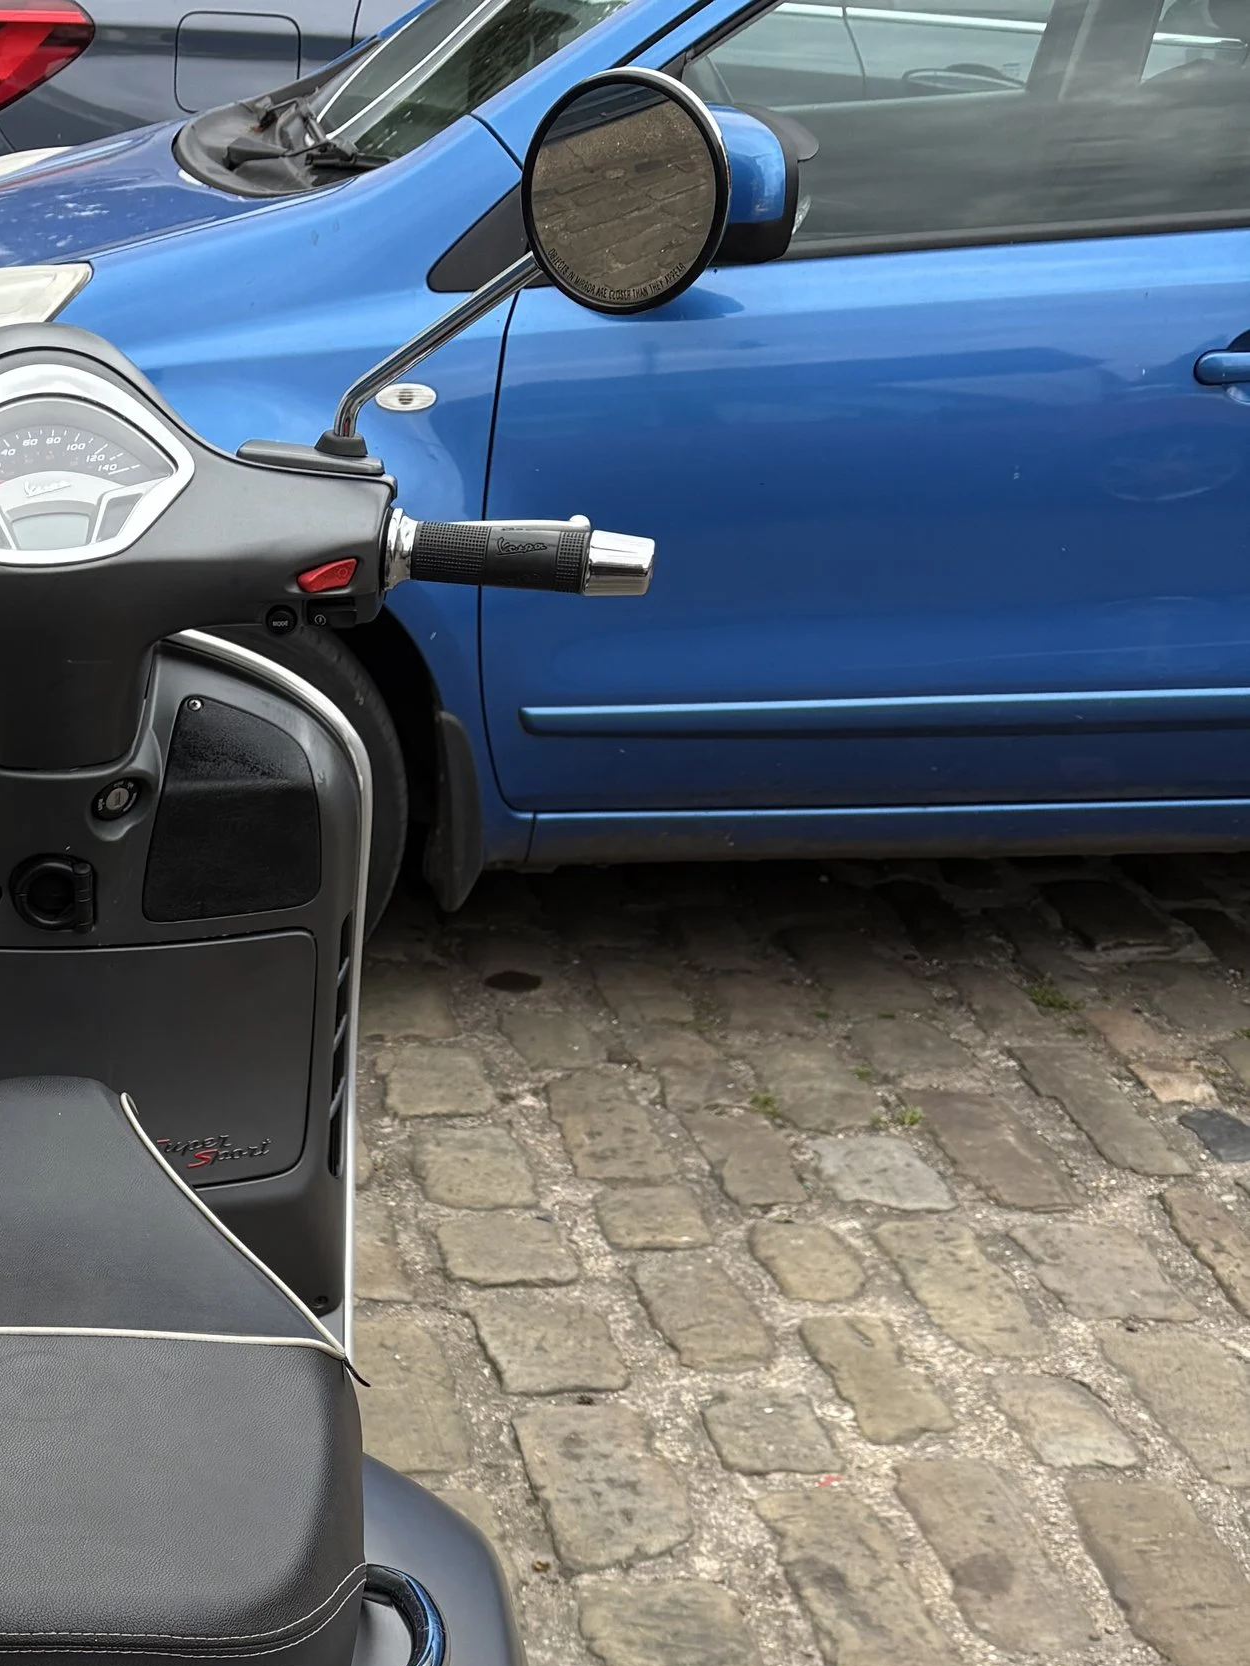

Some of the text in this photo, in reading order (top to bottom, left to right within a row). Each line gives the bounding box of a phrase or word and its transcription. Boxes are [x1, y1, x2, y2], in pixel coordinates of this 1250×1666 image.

[548, 248, 569, 275] OBJECTS
[572, 275, 595, 295] MIRROR
[595, 287, 607, 299] ARE
[609, 289, 631, 301] CLOSER
[632, 286, 649, 299] THAN
[649, 279, 664, 295] THEY
[664, 262, 686, 286] APPEAR
[22, 438, 38, 446] 60
[46, 436, 61, 444] 80
[67, 443, 86, 451] 100
[86, 454, 105, 462] 120
[98, 463, 118, 472] 140
[496, 536, 548, 556] Vespa
[186, 1138, 272, 1169] Sport
